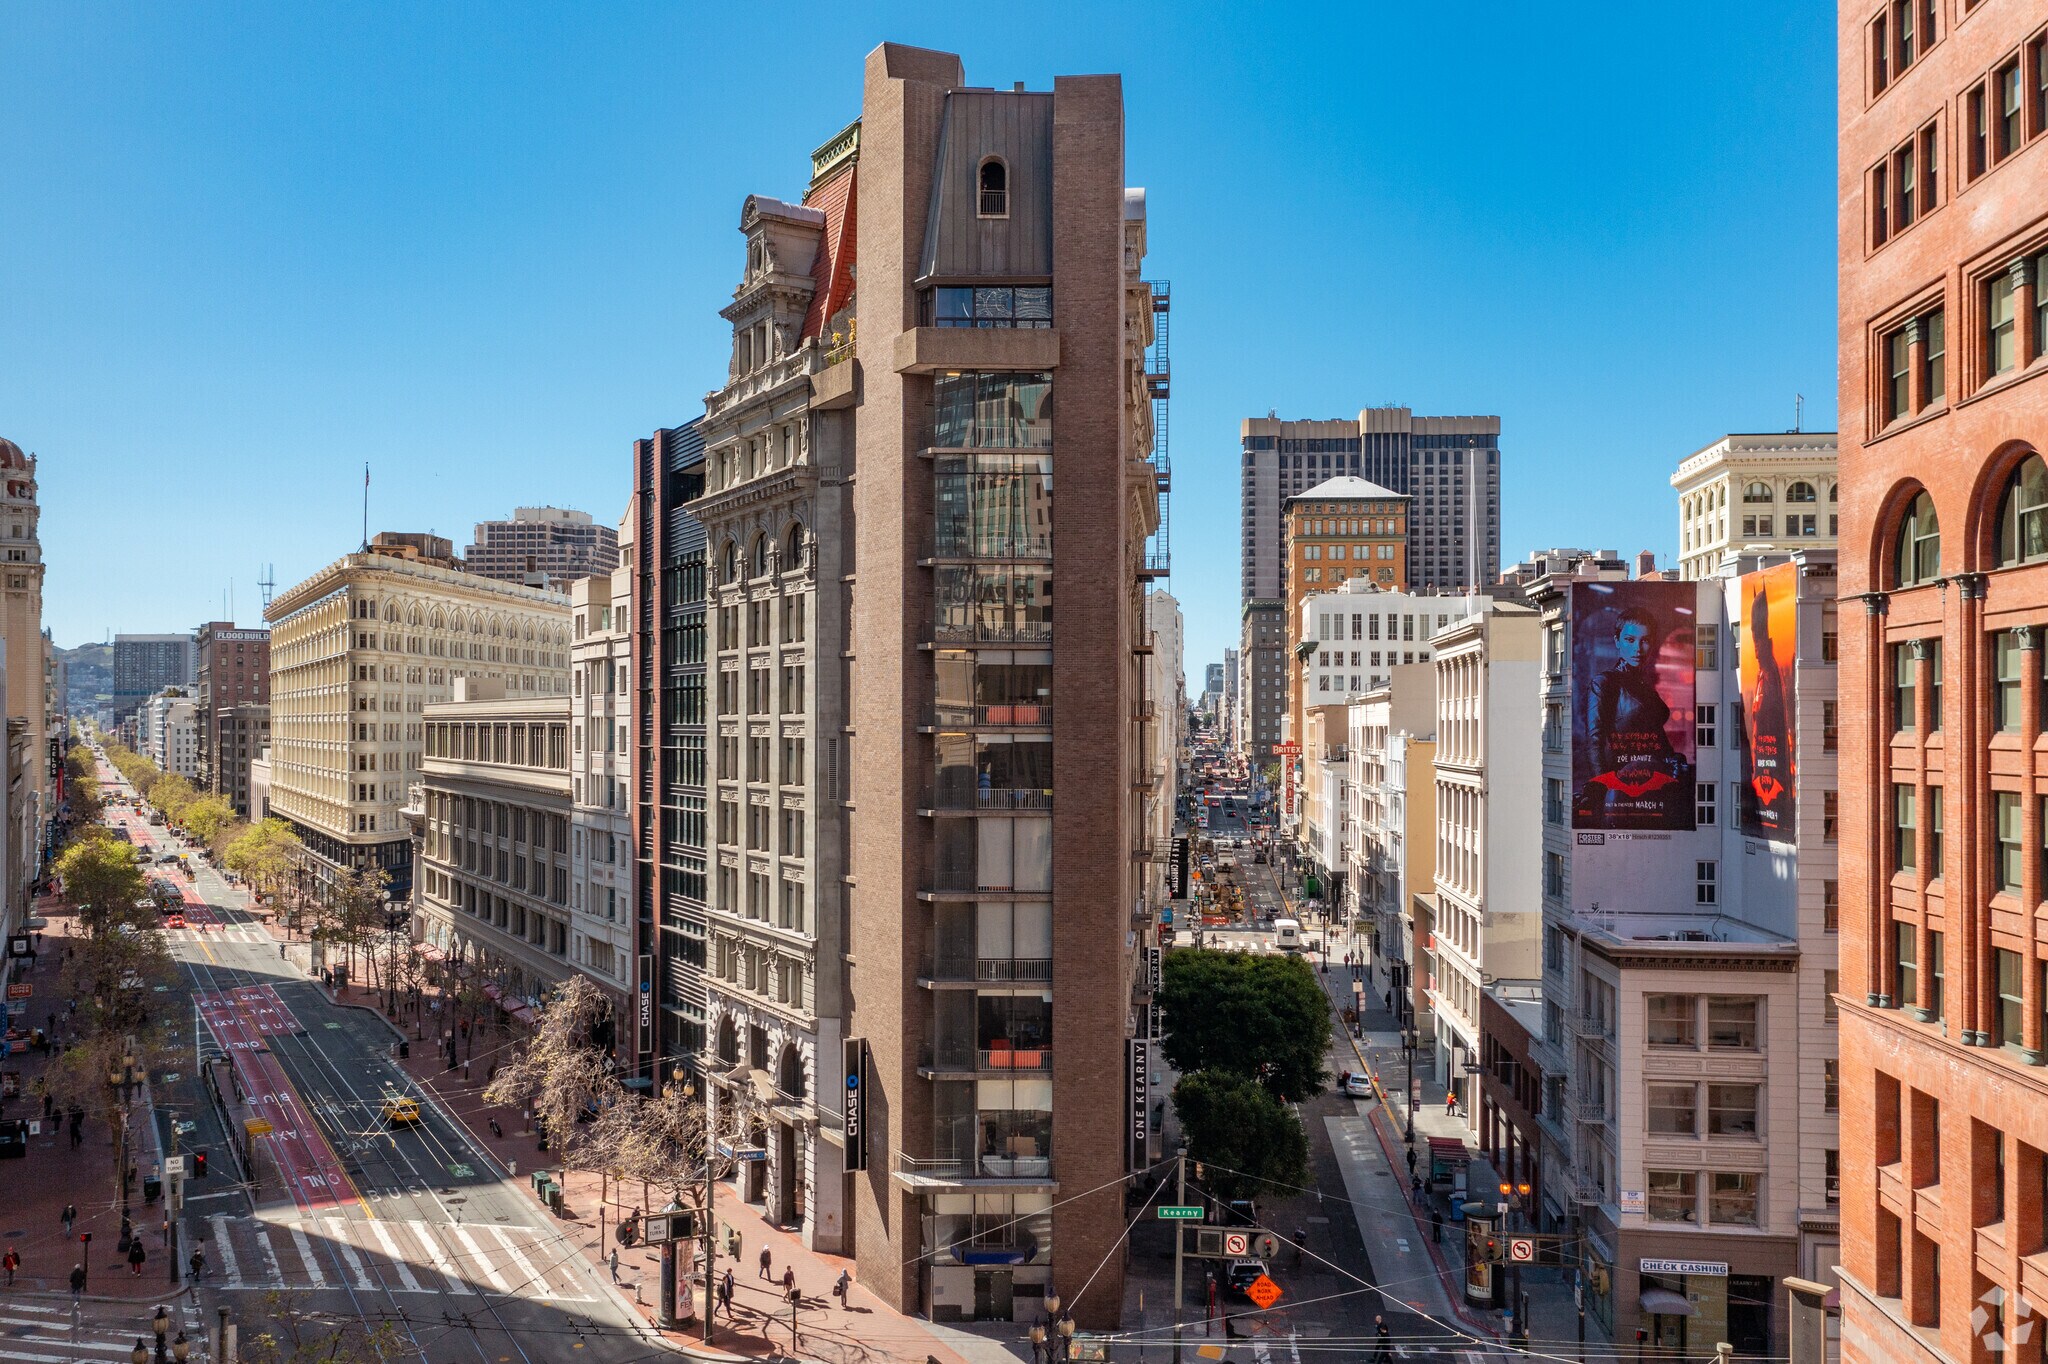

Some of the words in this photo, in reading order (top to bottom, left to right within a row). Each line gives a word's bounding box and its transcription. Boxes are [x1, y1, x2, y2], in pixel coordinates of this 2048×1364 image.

[1273, 745, 1301, 755] BRITEX
[1636, 801, 1657, 810] MARCH
[250, 1007, 281, 1015] TAXI
[641, 992, 649, 1027] CHASE
[225, 1041, 260, 1050] ONLY
[1136, 1045, 1145, 1103] KEARNY
[247, 1092, 290, 1105] BUS
[848, 1089, 858, 1136] CHASE
[1136, 1110, 1145, 1139] ONE
[367, 1186, 422, 1203] BUS
[1163, 1209, 1198, 1217] Kearny
[1642, 1262, 1678, 1271] CHECK
[1680, 1264, 1727, 1273] CASHING
